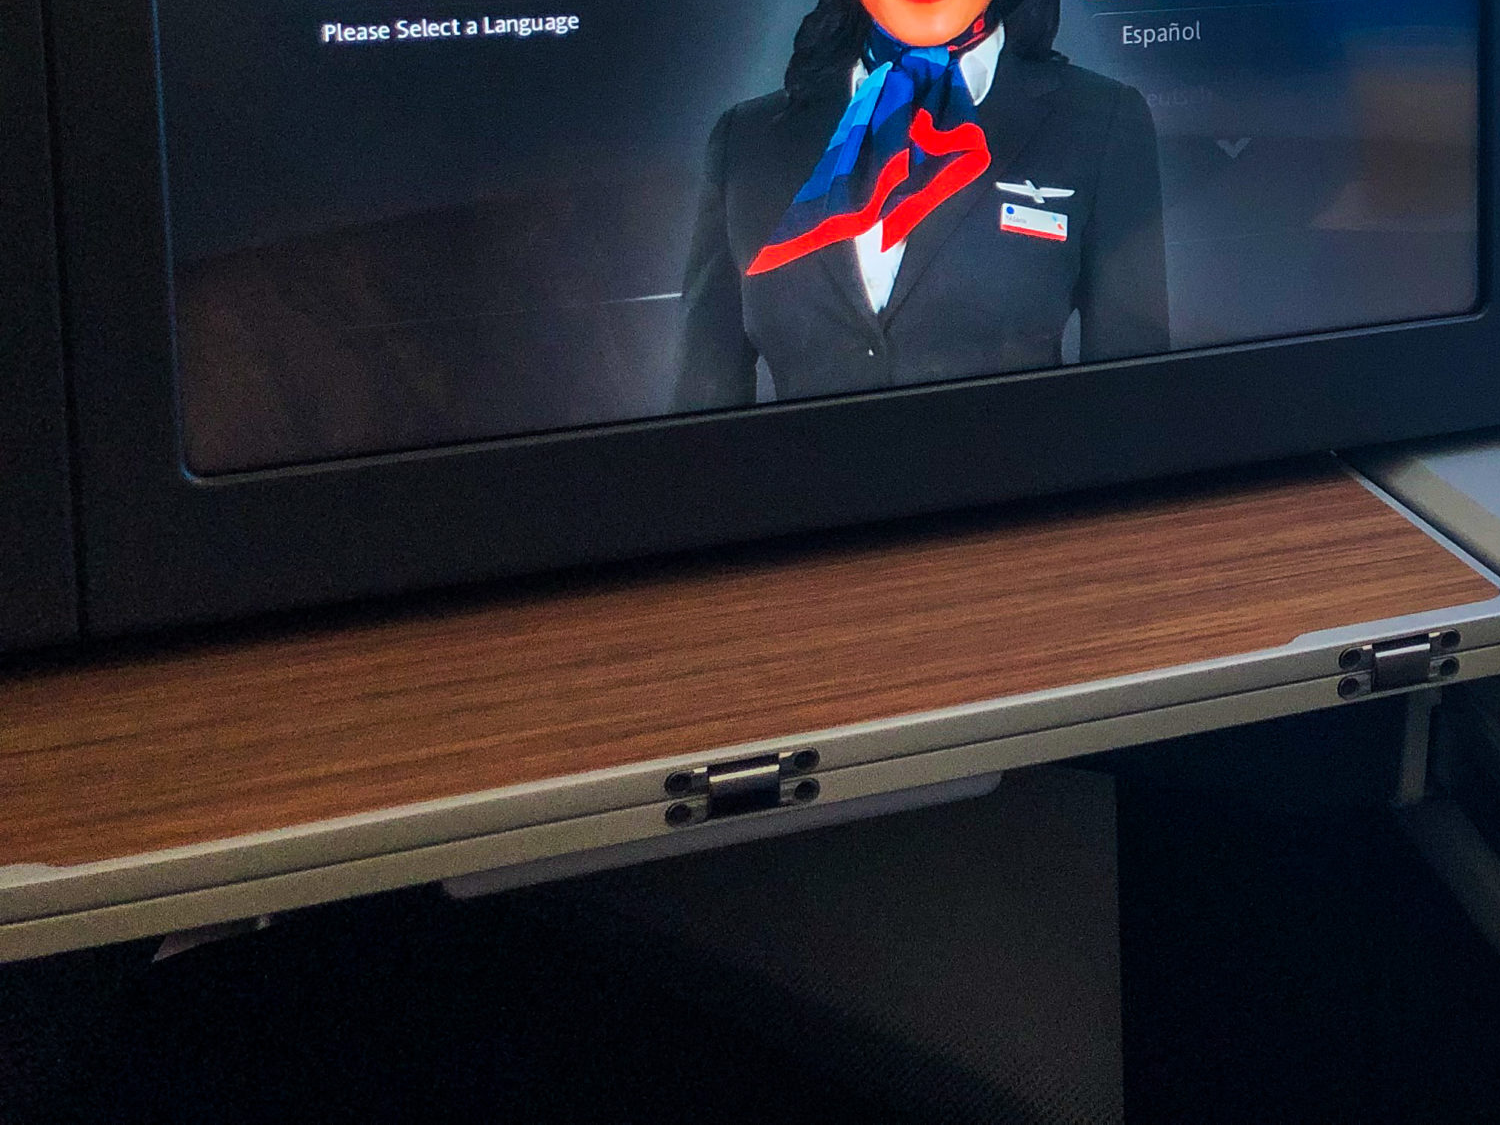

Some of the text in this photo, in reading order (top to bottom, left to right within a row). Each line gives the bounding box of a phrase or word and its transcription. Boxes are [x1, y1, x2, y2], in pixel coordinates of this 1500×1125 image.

[322, 15, 580, 42] Please Select a Language
[1122, 21, 1201, 47] Español
